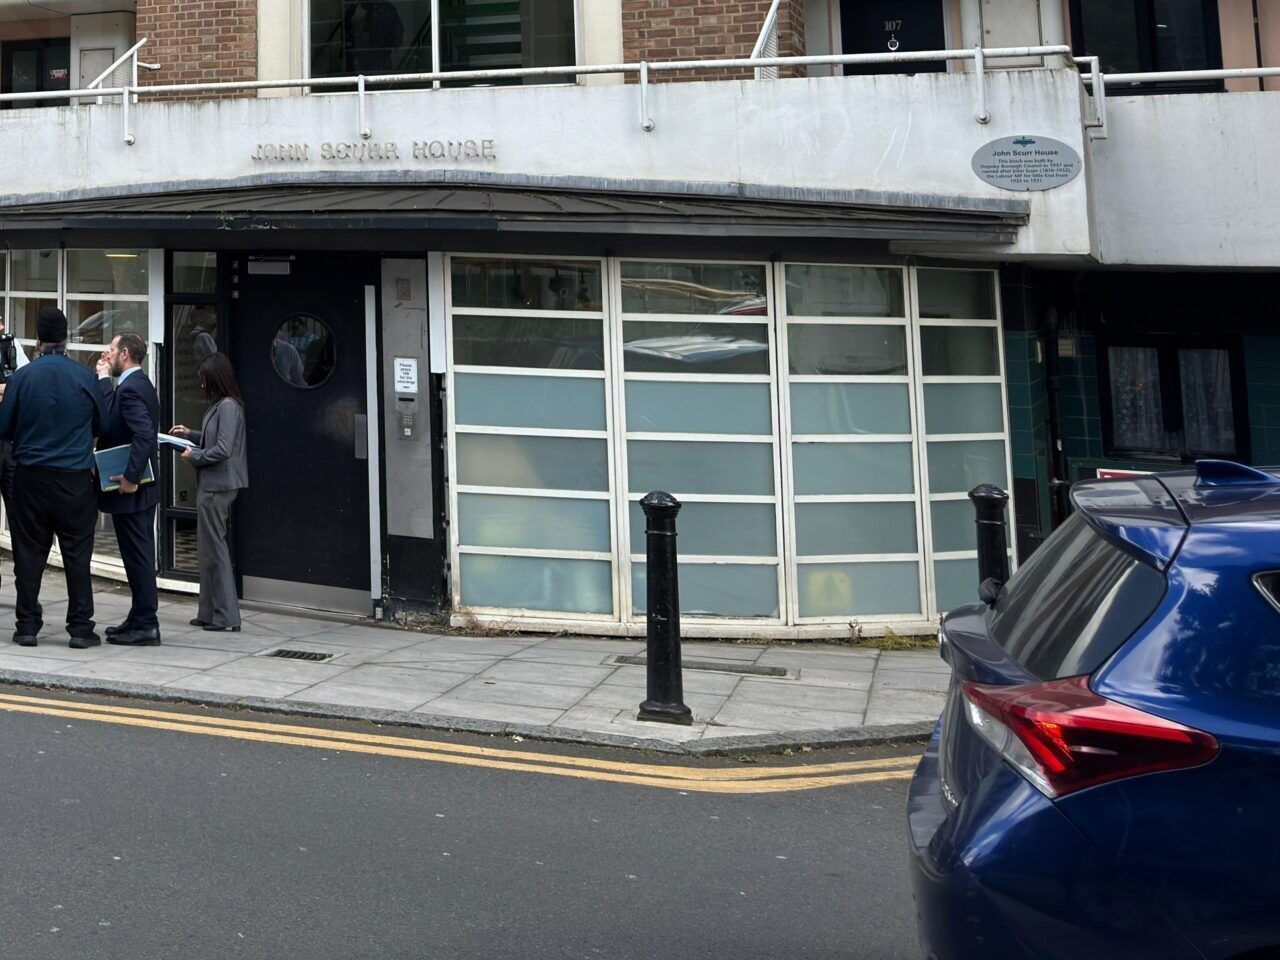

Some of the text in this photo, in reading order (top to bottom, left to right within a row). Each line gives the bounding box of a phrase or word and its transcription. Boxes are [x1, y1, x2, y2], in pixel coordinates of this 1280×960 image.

[884, 20, 902, 31] 107
[251, 140, 496, 160] JOHN SCURR HOUSE
